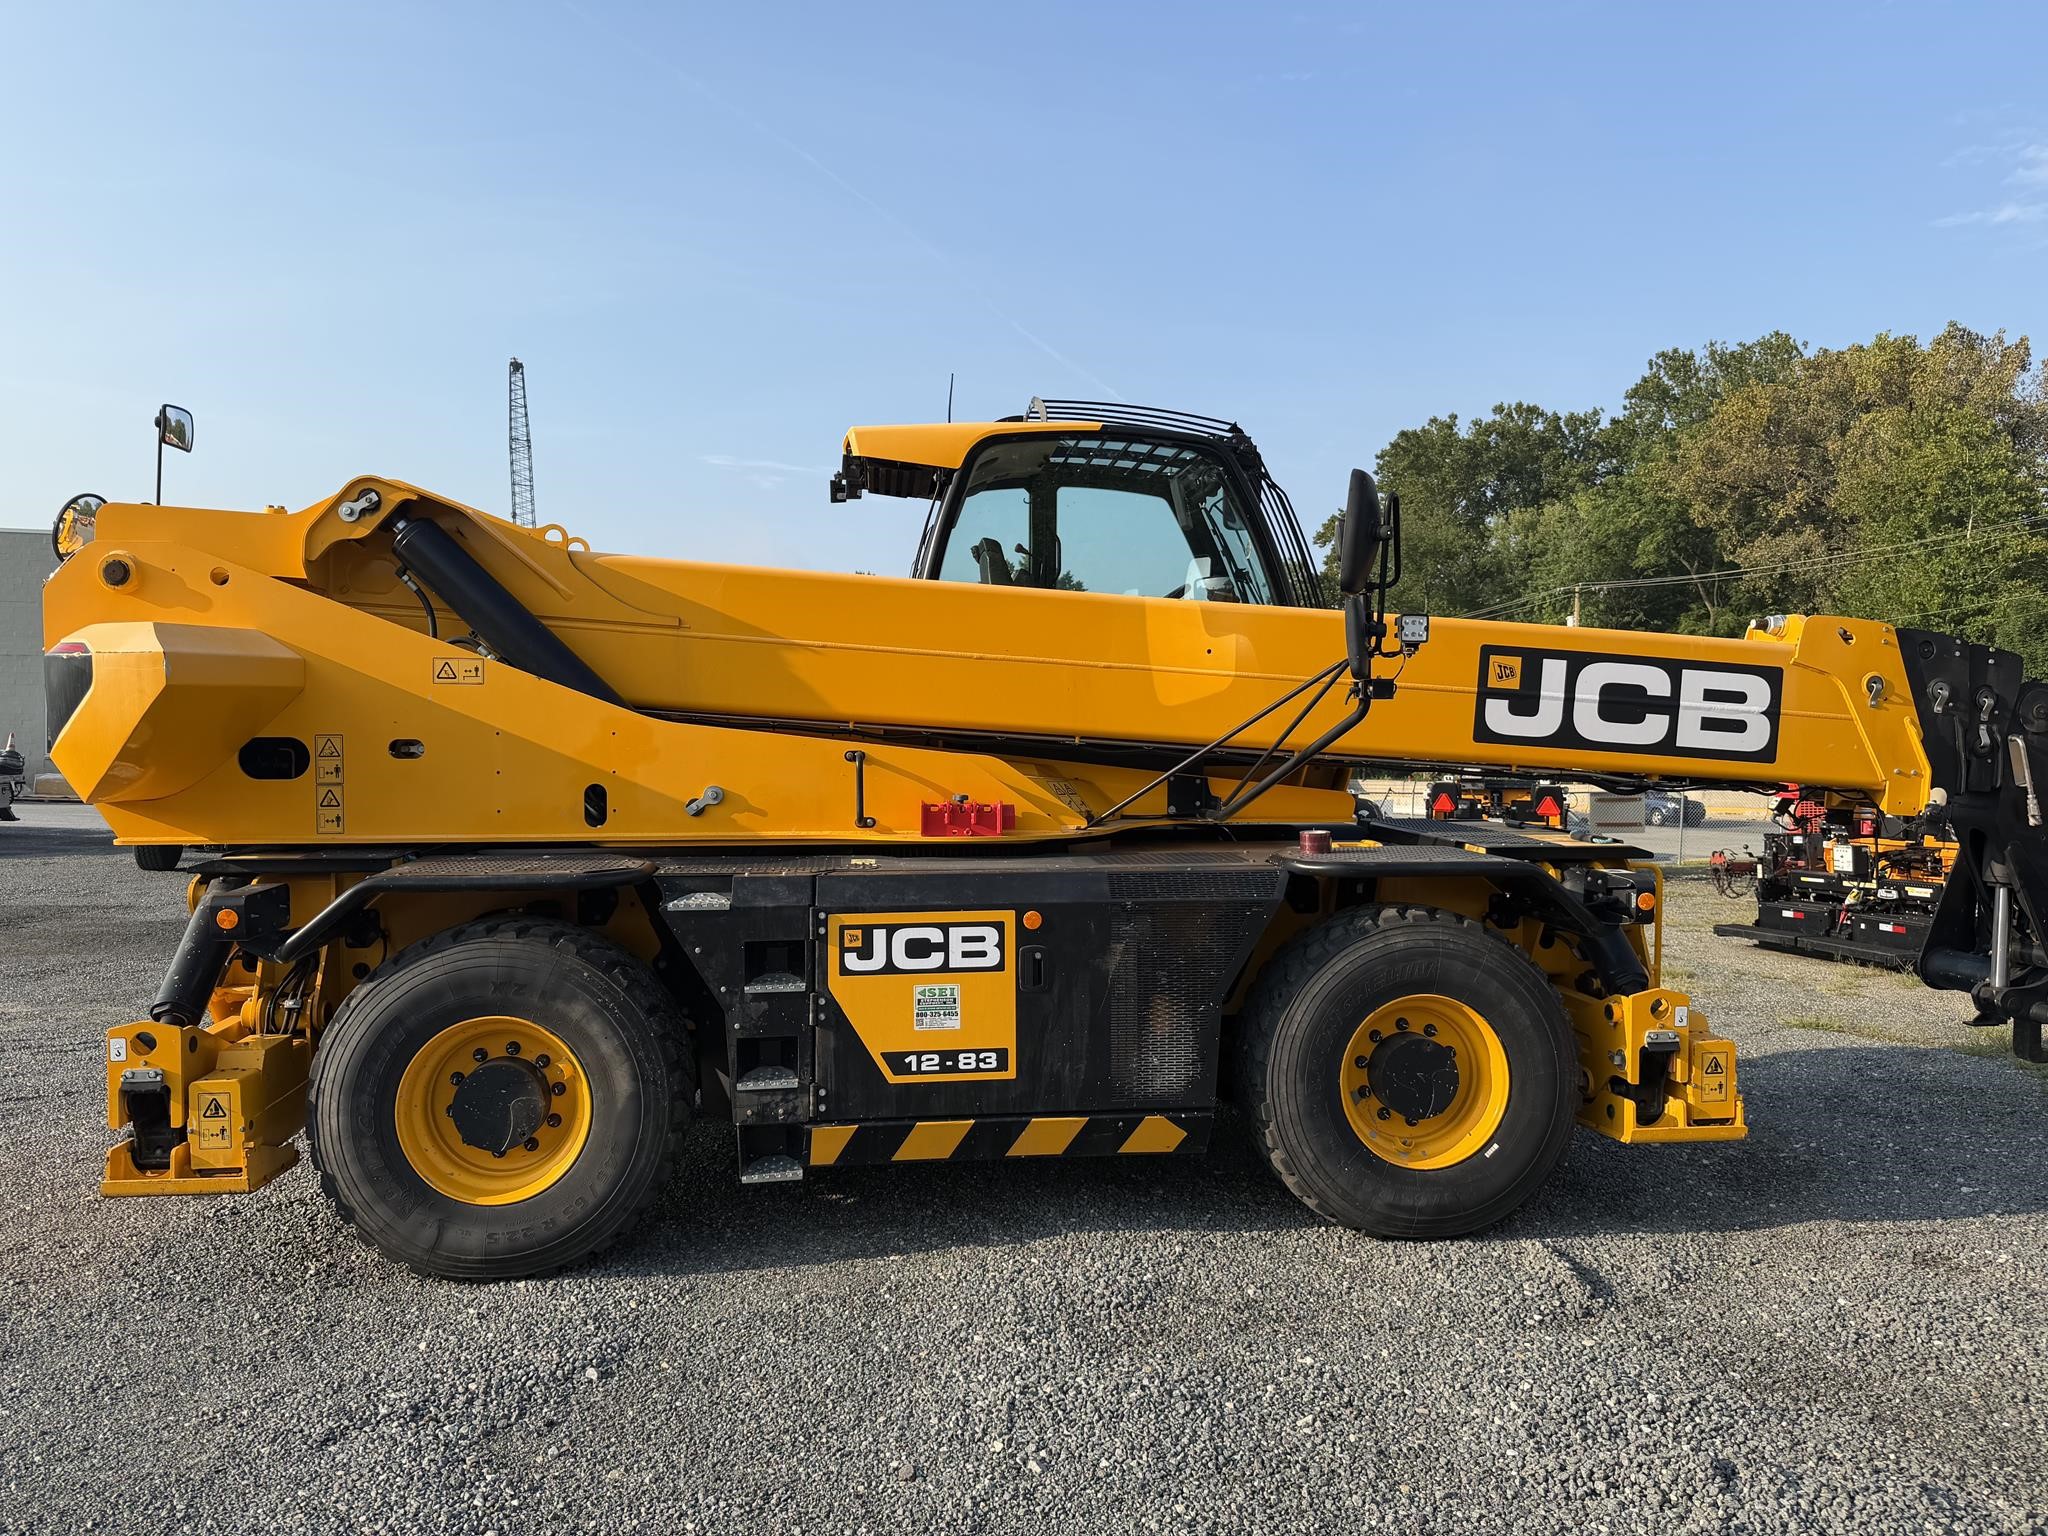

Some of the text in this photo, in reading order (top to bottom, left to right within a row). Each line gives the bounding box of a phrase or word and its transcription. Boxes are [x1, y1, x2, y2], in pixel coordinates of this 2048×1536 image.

[1497, 664, 1515, 679] JCB
[1484, 658, 1771, 752] JCB
[844, 926, 1000, 971] JCB
[927, 987, 955, 997] SEI
